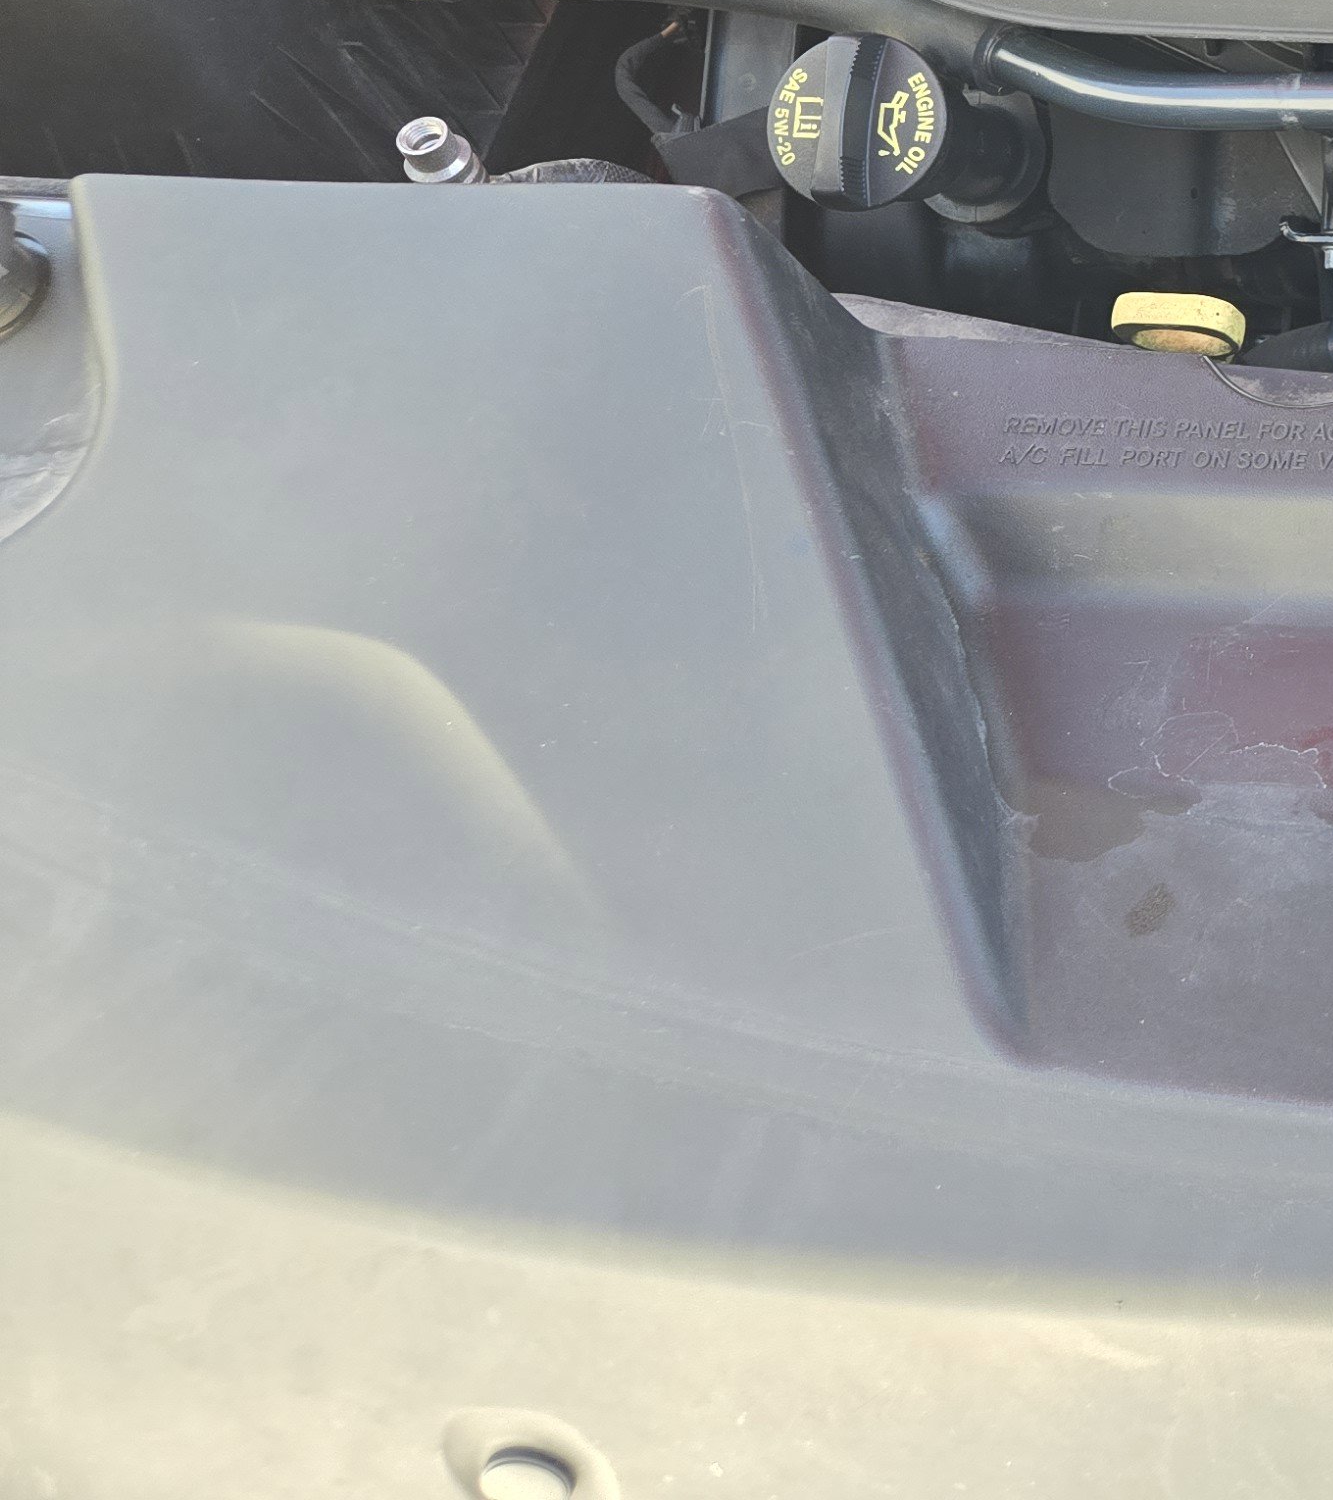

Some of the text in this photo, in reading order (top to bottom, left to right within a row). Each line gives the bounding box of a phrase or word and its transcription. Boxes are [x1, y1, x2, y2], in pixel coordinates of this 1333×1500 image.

[773, 68, 808, 166] SAE 5W-20
[894, 72, 934, 175] ENGINE OIL
[998, 443, 1048, 465] A/C
[1058, 446, 1109, 466] FILL
[1120, 448, 1183, 468] PORT
[1193, 450, 1231, 469] ON
[1236, 451, 1308, 471] SOME
[1002, 415, 1107, 436] REMOVE
[1112, 417, 1169, 438] THIS
[1174, 419, 1249, 439] PANEL
[1258, 421, 1305, 442] FOR
